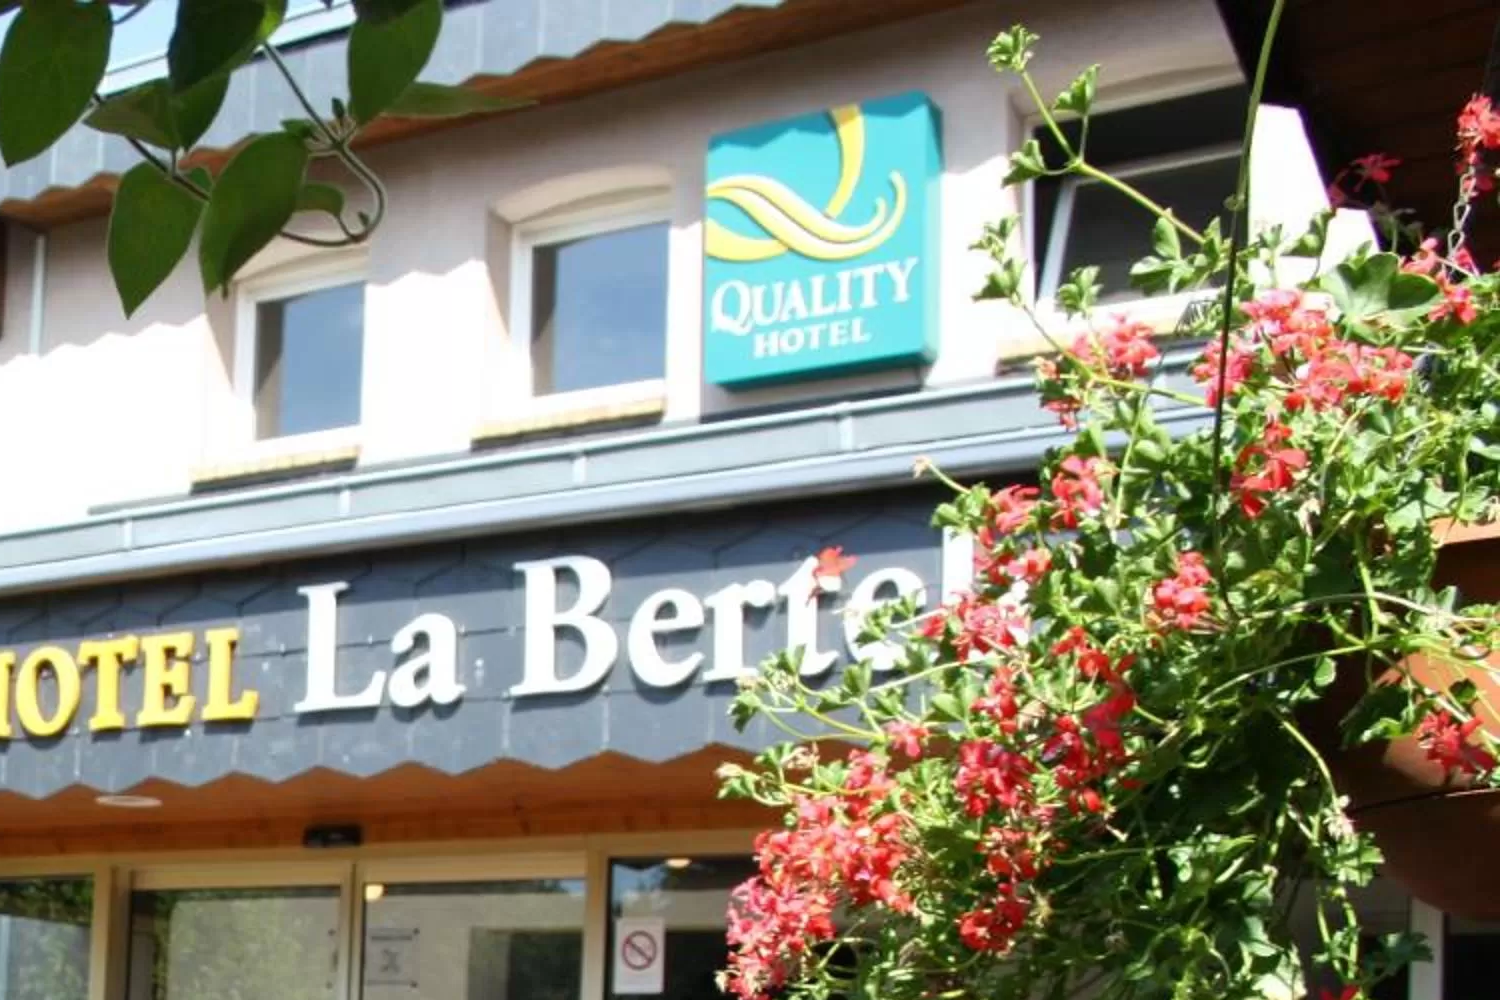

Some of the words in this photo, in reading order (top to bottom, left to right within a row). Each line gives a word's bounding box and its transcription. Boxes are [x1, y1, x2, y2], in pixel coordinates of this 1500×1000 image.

[711, 256, 919, 336] QUALITY
[753, 317, 871, 358] HOTEL
[295, 581, 466, 712] La
